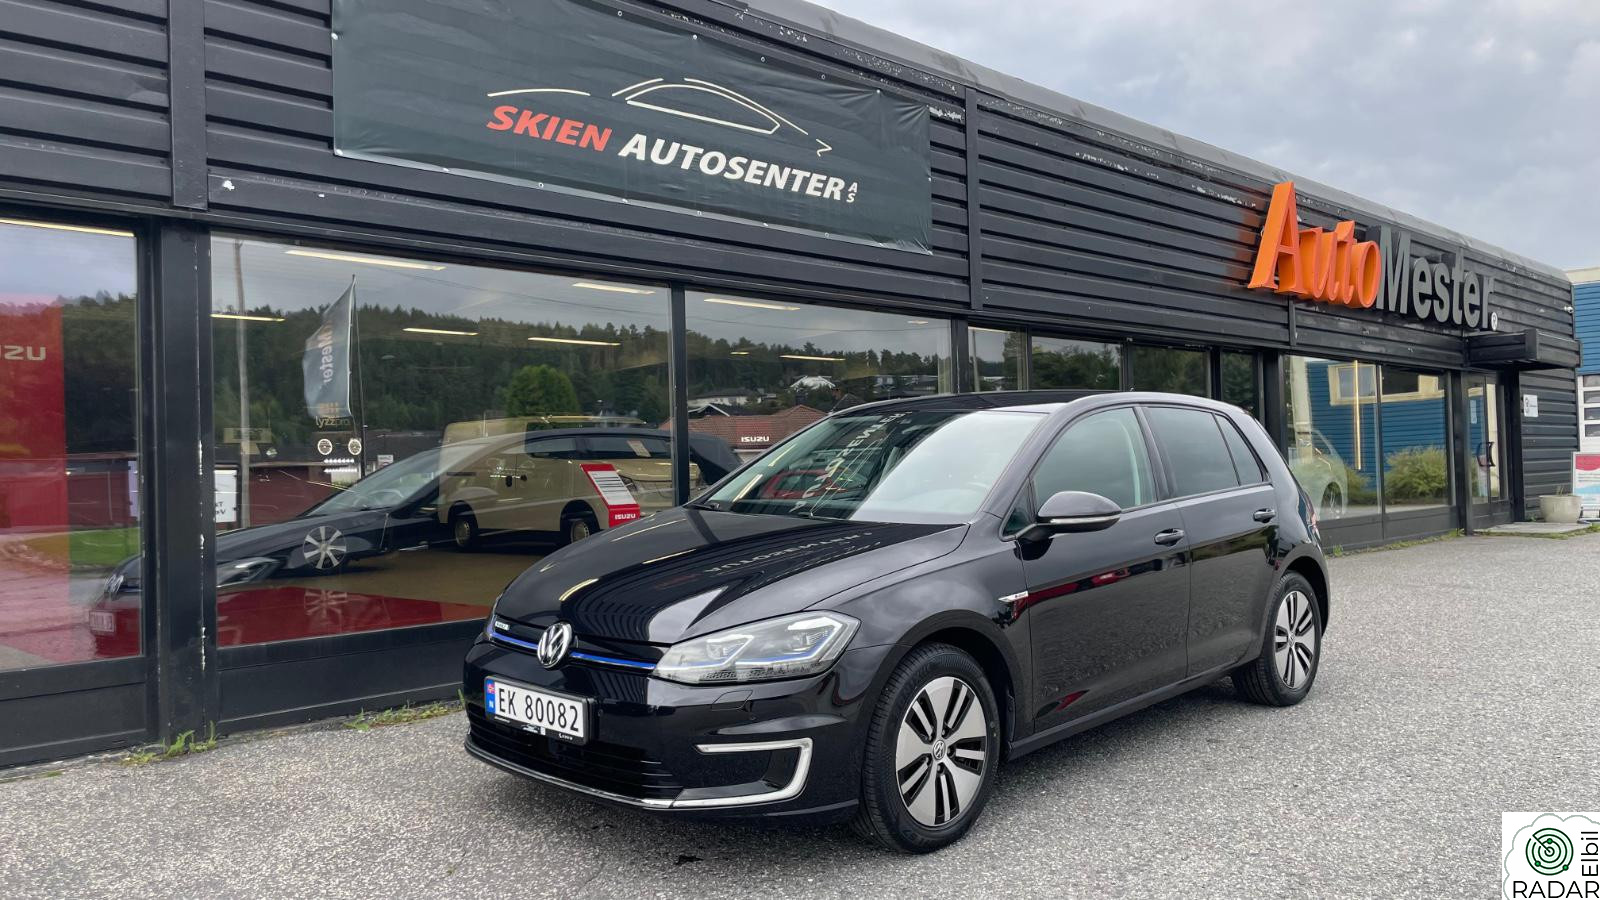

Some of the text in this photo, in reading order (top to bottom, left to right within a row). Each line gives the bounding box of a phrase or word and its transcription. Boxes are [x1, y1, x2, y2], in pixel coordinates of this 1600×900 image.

[486, 105, 612, 152] SKIEN
[617, 133, 846, 201] AUTOSENTER
[0, 344, 46, 361] ZU
[740, 435, 770, 443] ISUZU
[498, 687, 517, 716] EK
[525, 694, 579, 732] 80082
